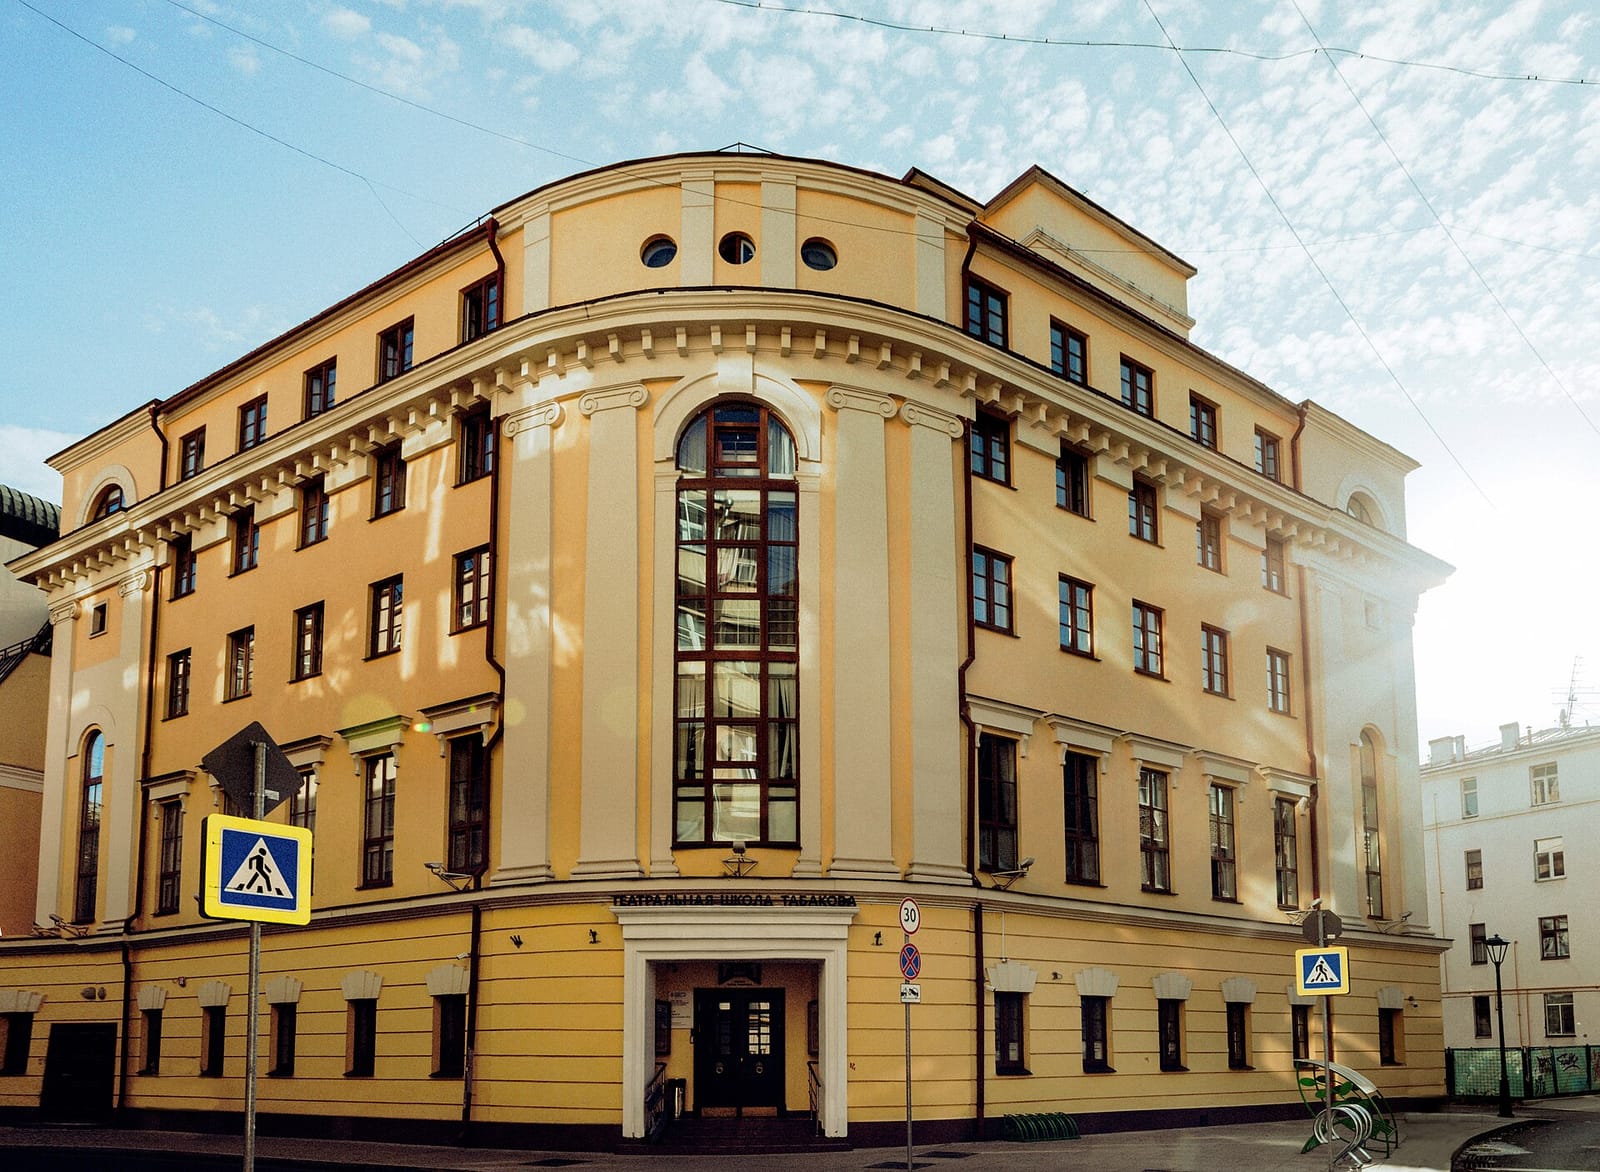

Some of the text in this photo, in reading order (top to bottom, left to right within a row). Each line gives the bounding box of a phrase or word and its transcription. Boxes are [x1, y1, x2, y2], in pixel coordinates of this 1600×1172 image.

[612, 894, 857, 907] ТЕАТРАЛЬНАЯ ШКОЛА ТАБАКОВА
[903, 907, 917, 922] 30
